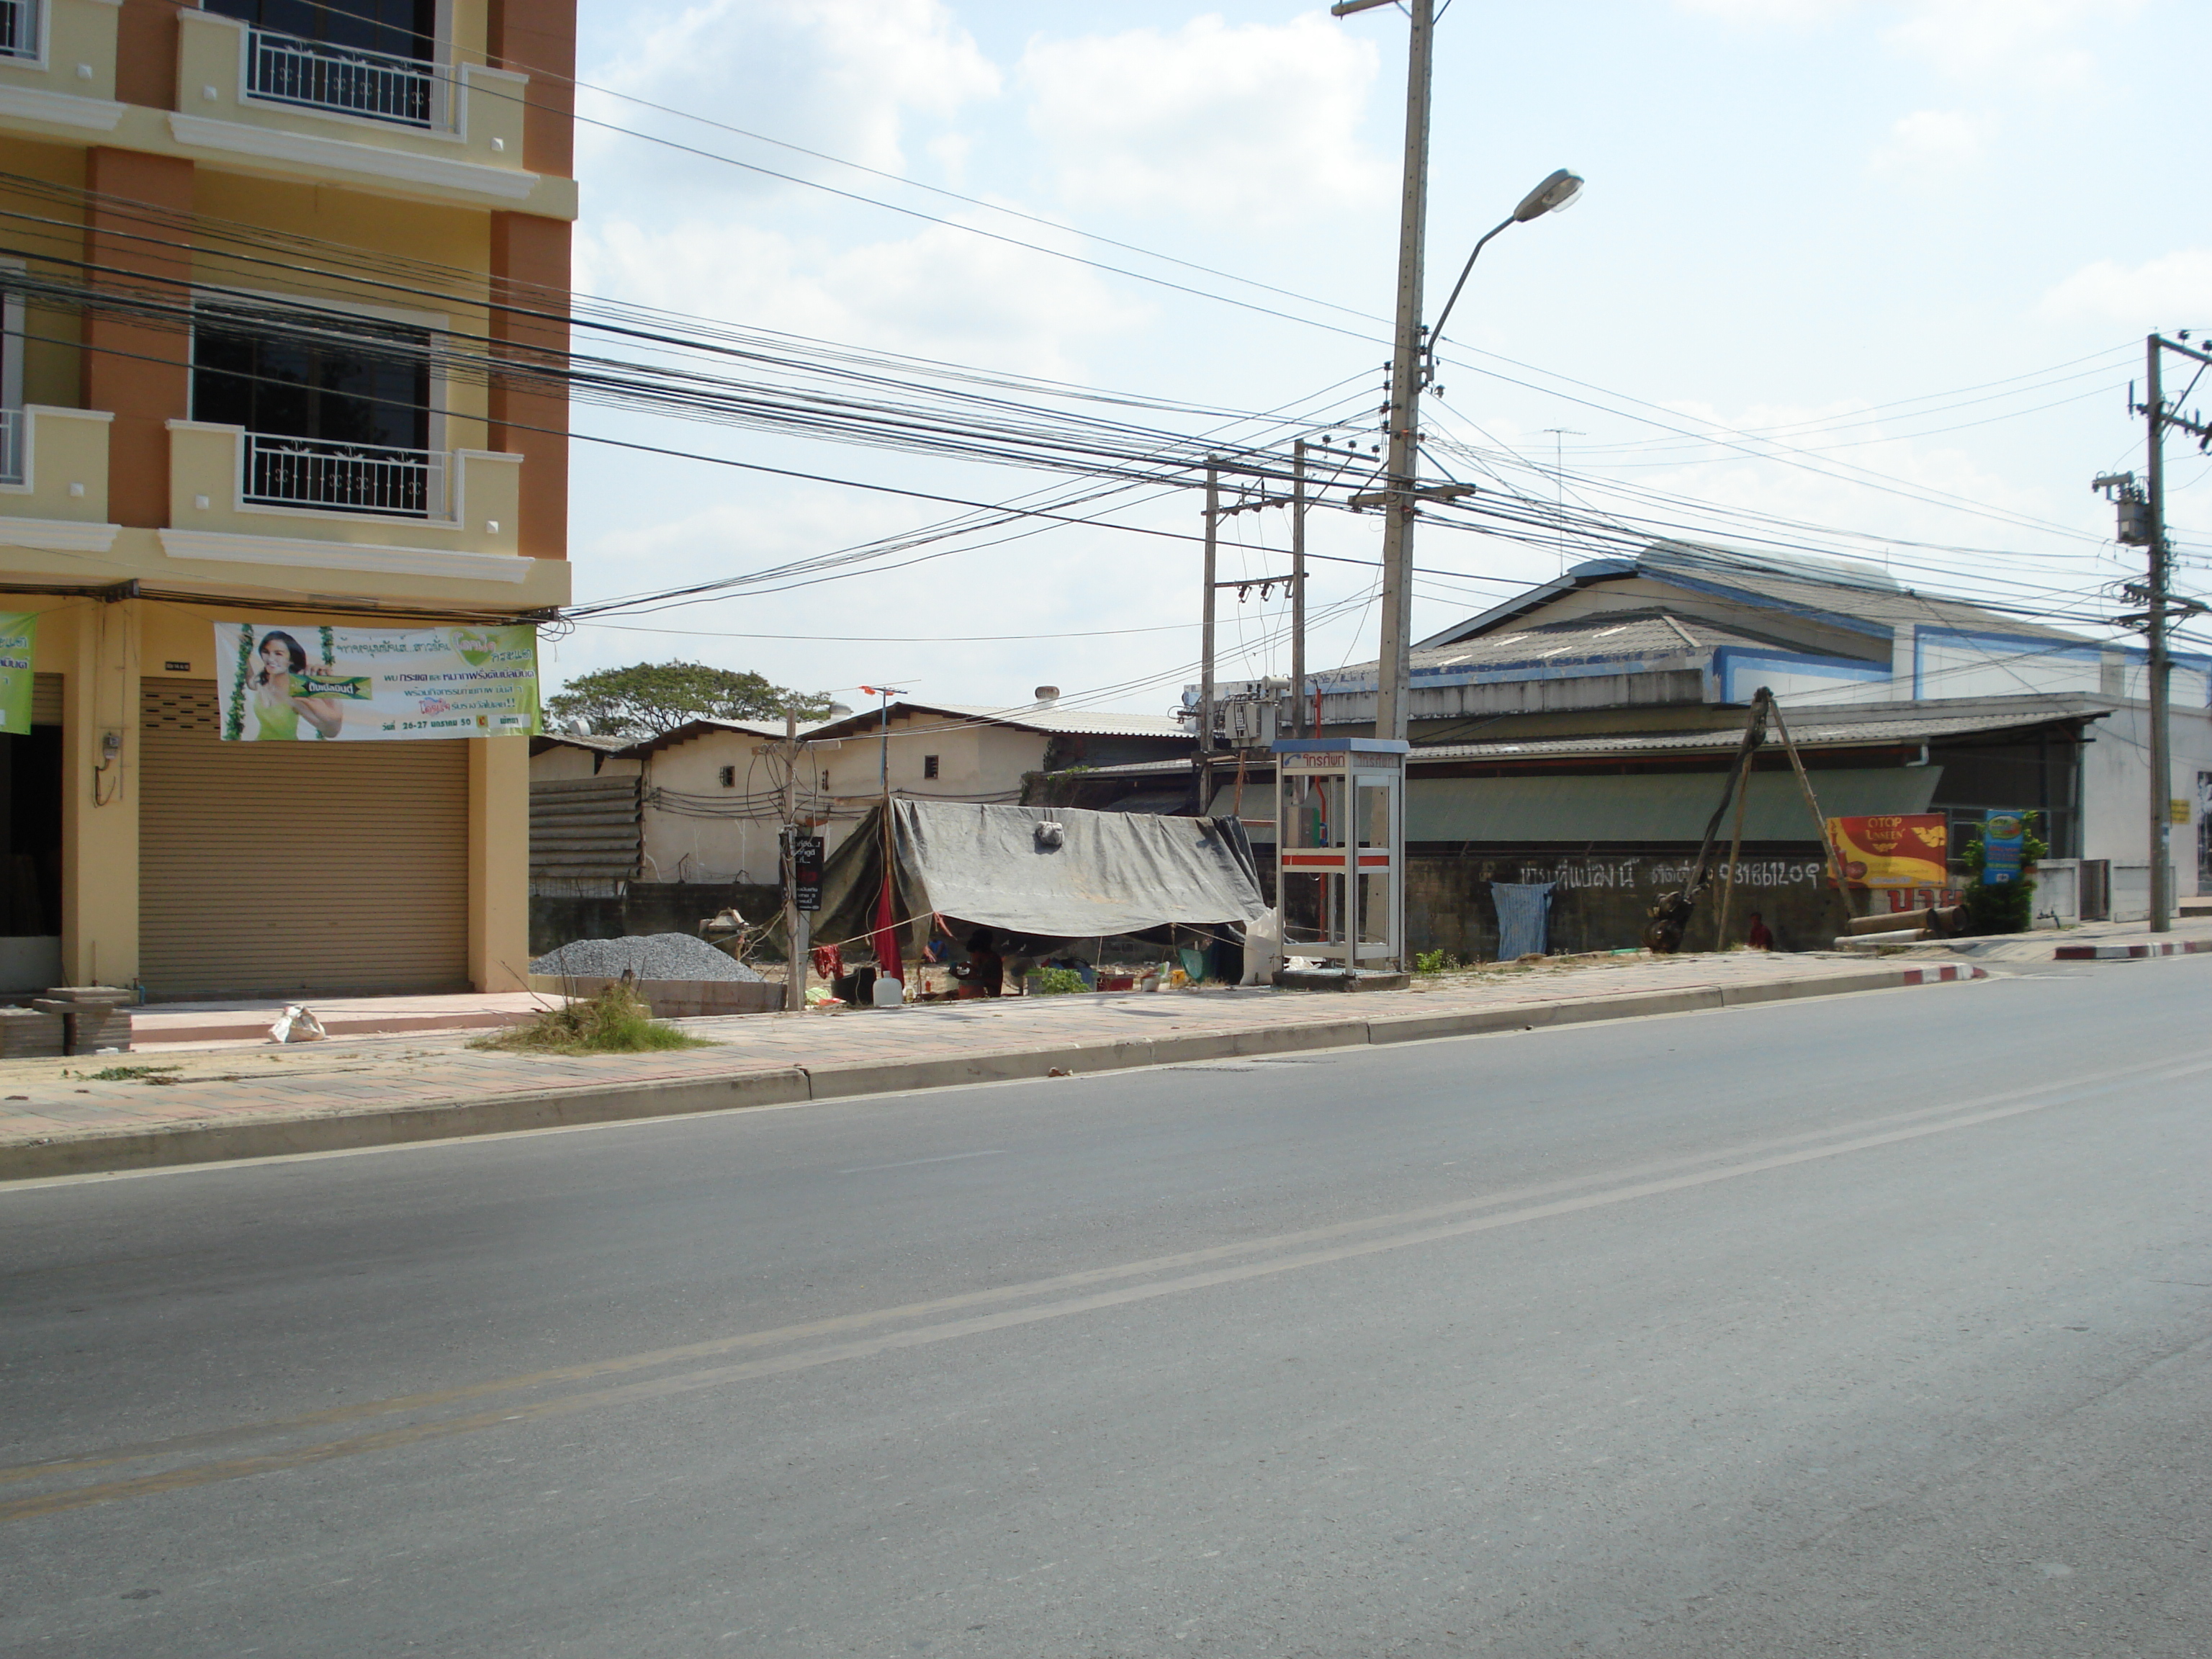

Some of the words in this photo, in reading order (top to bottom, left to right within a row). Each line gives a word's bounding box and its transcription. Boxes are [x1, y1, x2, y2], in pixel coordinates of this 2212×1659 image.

[384, 673, 399, 682] พบ
[400, 673, 428, 682] กระแต
[403, 719, 428, 730] 26-27
[461, 717, 472, 727] 50
[1868, 817, 1902, 828] OTOP
